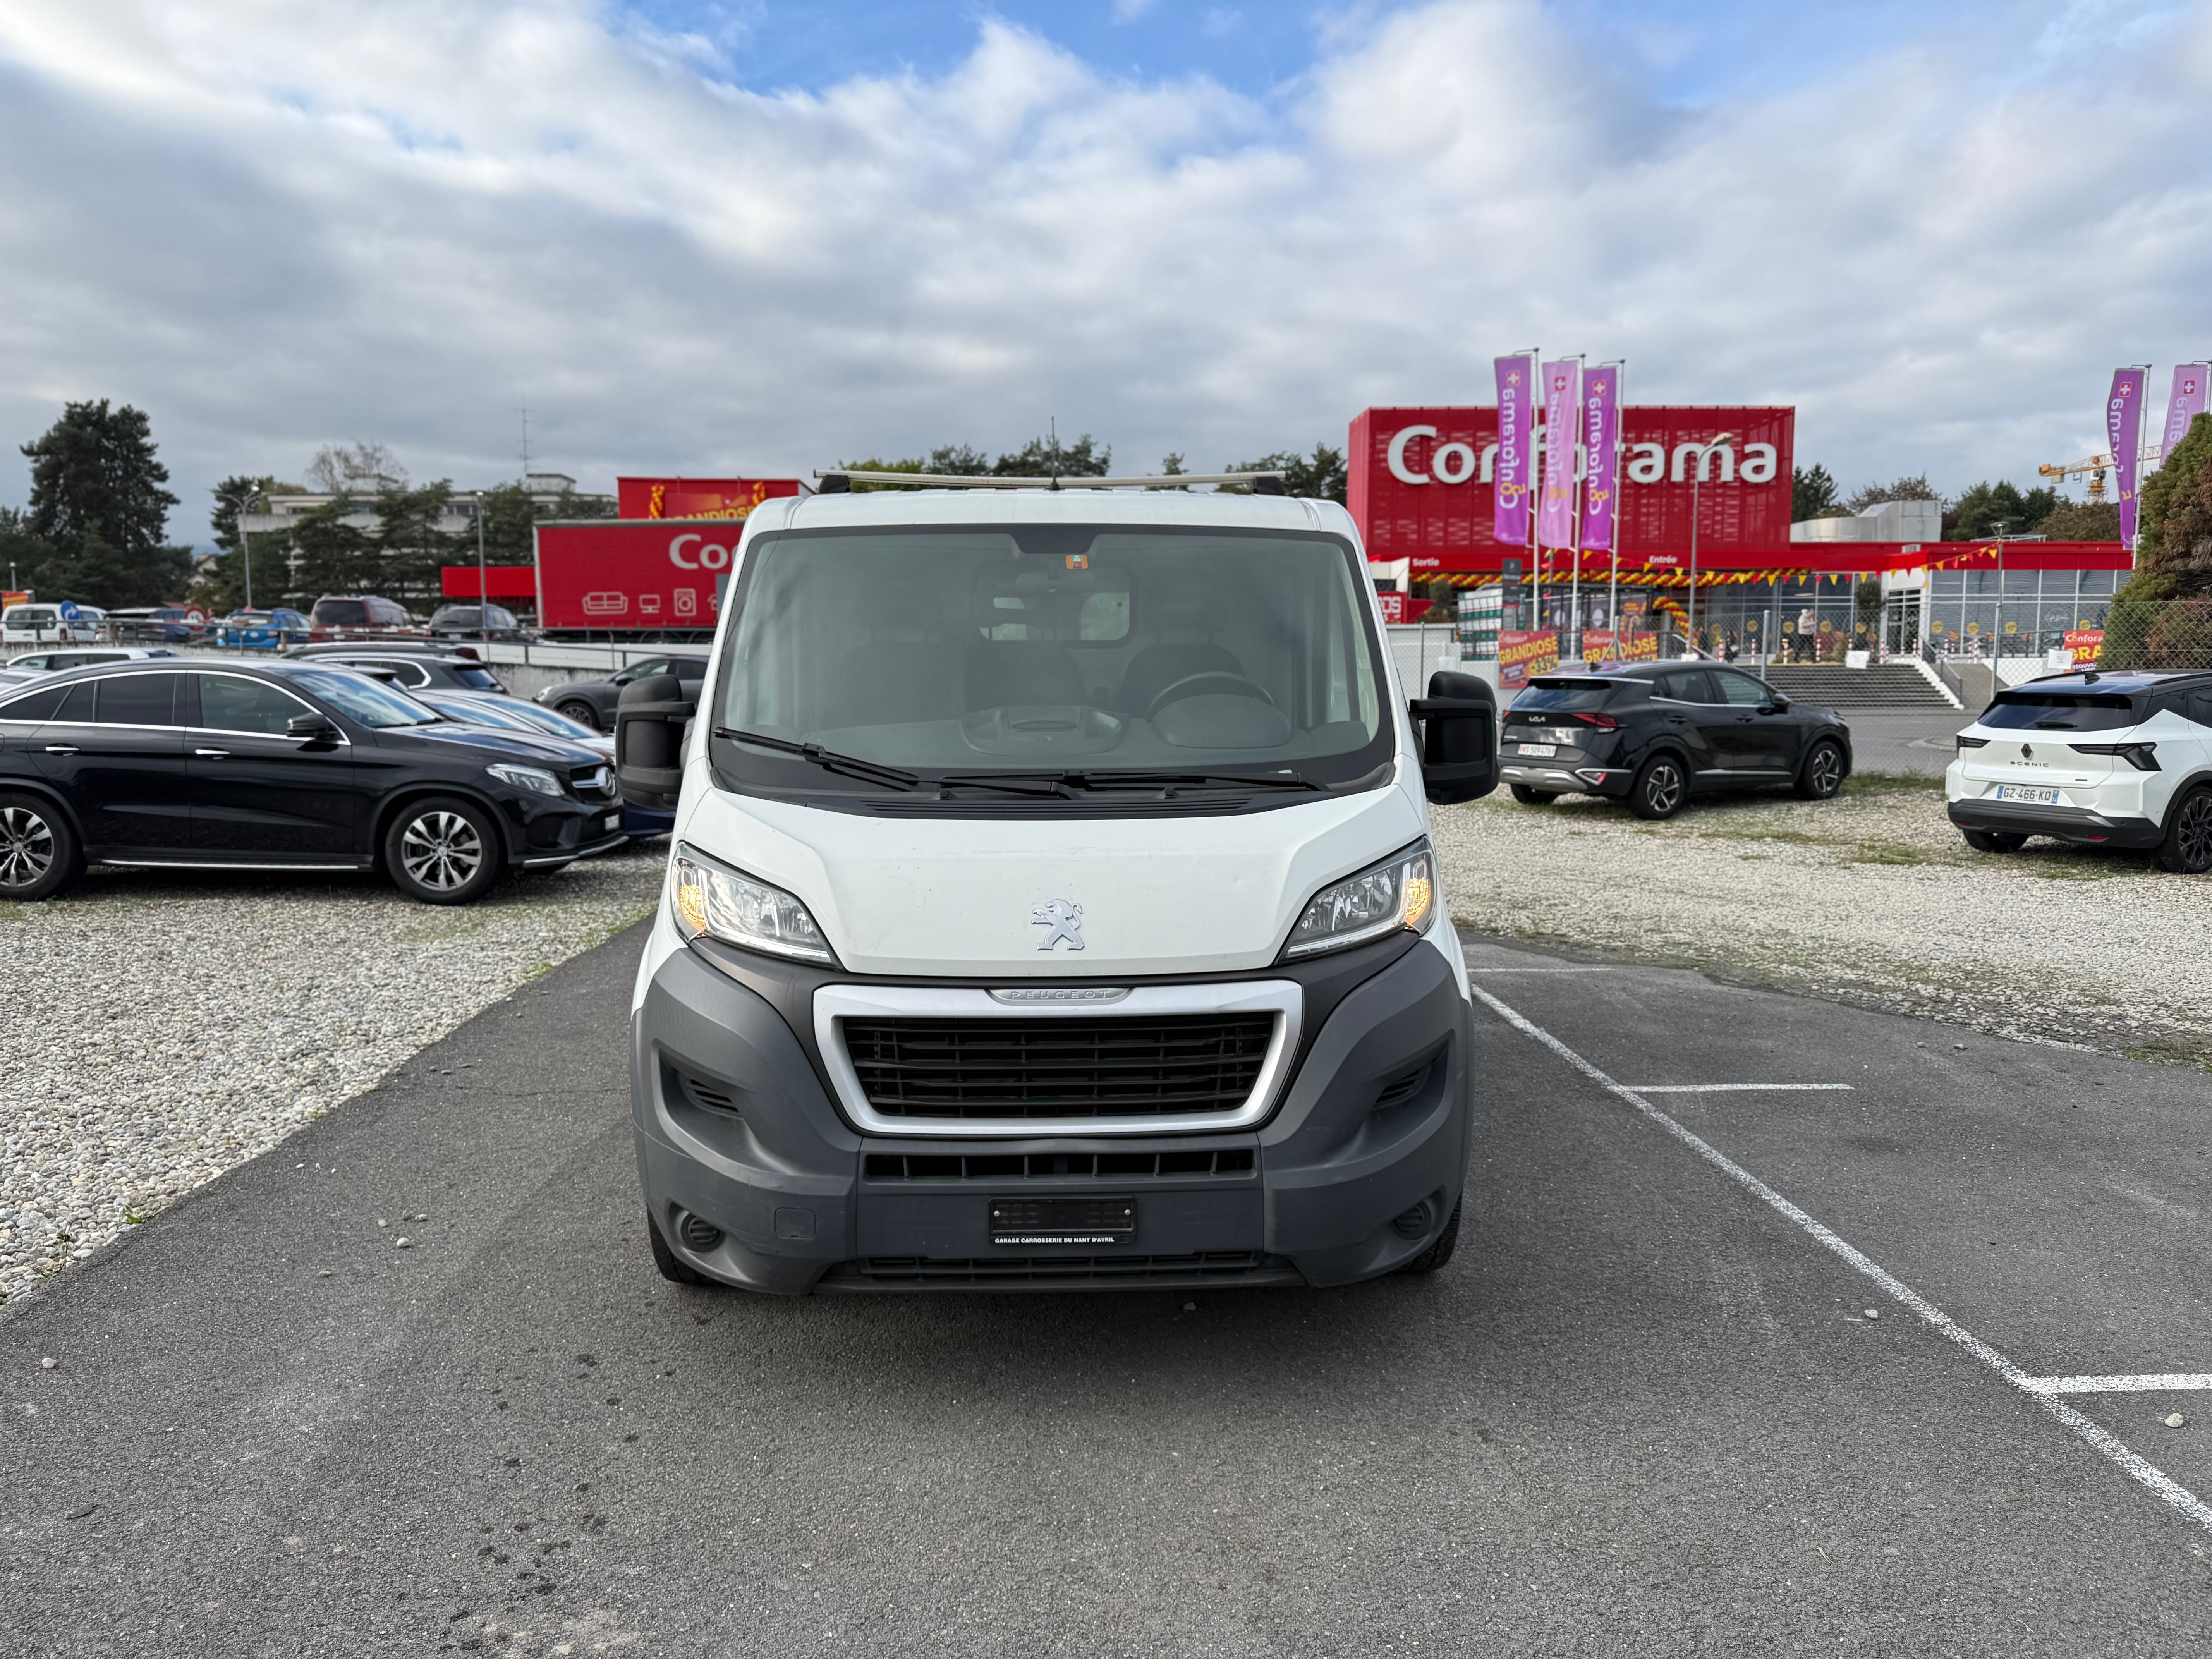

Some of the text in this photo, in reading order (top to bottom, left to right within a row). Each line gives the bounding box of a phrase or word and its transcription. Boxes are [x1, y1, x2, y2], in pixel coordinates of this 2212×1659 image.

[1413, 558, 1440, 567] Sortie
[1649, 555, 1677, 564] Entrée
[1499, 636, 1558, 665] GRANDIOSE
[1011, 990, 1109, 999] PEUGEOT
